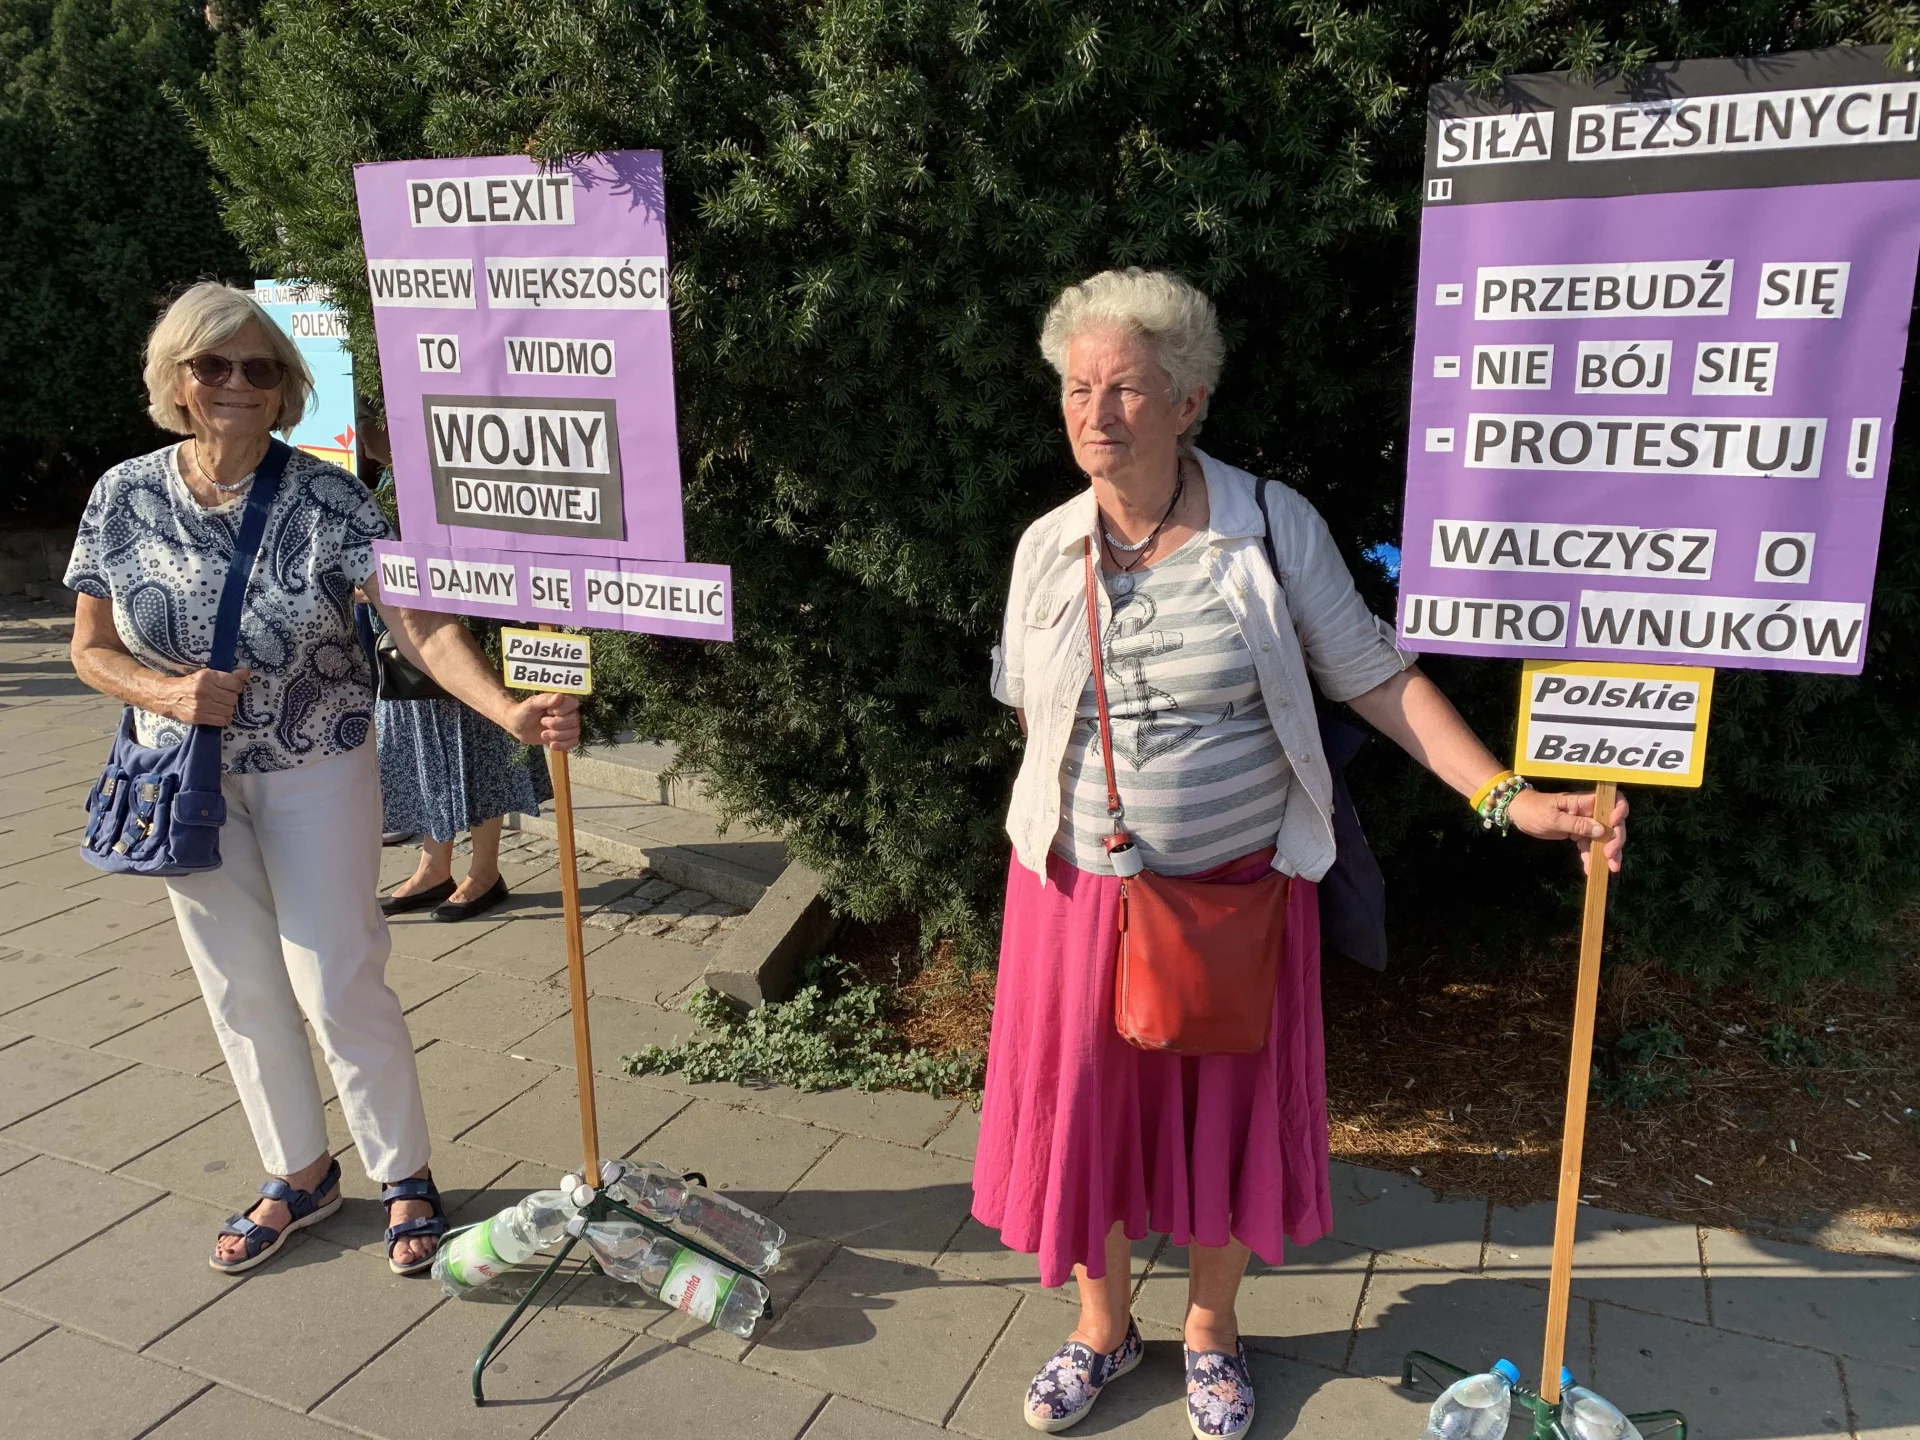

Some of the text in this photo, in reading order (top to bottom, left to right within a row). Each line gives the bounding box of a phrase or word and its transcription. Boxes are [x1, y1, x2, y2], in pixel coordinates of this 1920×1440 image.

[1443, 91, 1918, 162] SIŁA BEZSILNYCH
[411, 178, 569, 223] POLEXIT
[257, 289, 272, 304] CEL
[372, 259, 665, 306] WBREW WIĘKSZOŚCI
[1482, 260, 1726, 314] PRZEBUDŹ
[1763, 269, 1839, 314] SIĘ
[419, 338, 612, 376] TO WIDMO
[1477, 350, 1549, 385] NIE
[1581, 343, 1665, 388] BÓJ
[1698, 347, 1771, 392] SIĘ
[433, 413, 603, 468] WOJNY
[1474, 419, 1817, 472] PROTESTUJ
[455, 480, 597, 522] DOMOWEJ
[1438, 526, 1807, 577] WALCZYSZ O
[382, 562, 723, 617] NIE DAJMY SIĘ PODZIELIĆ
[509, 638, 583, 660] Polskie
[1405, 598, 1862, 658] JUTRO WNUKÓW
[512, 665, 583, 686] Babcie
[1534, 676, 1695, 712] Polskie
[1533, 734, 1685, 770] Babcie
